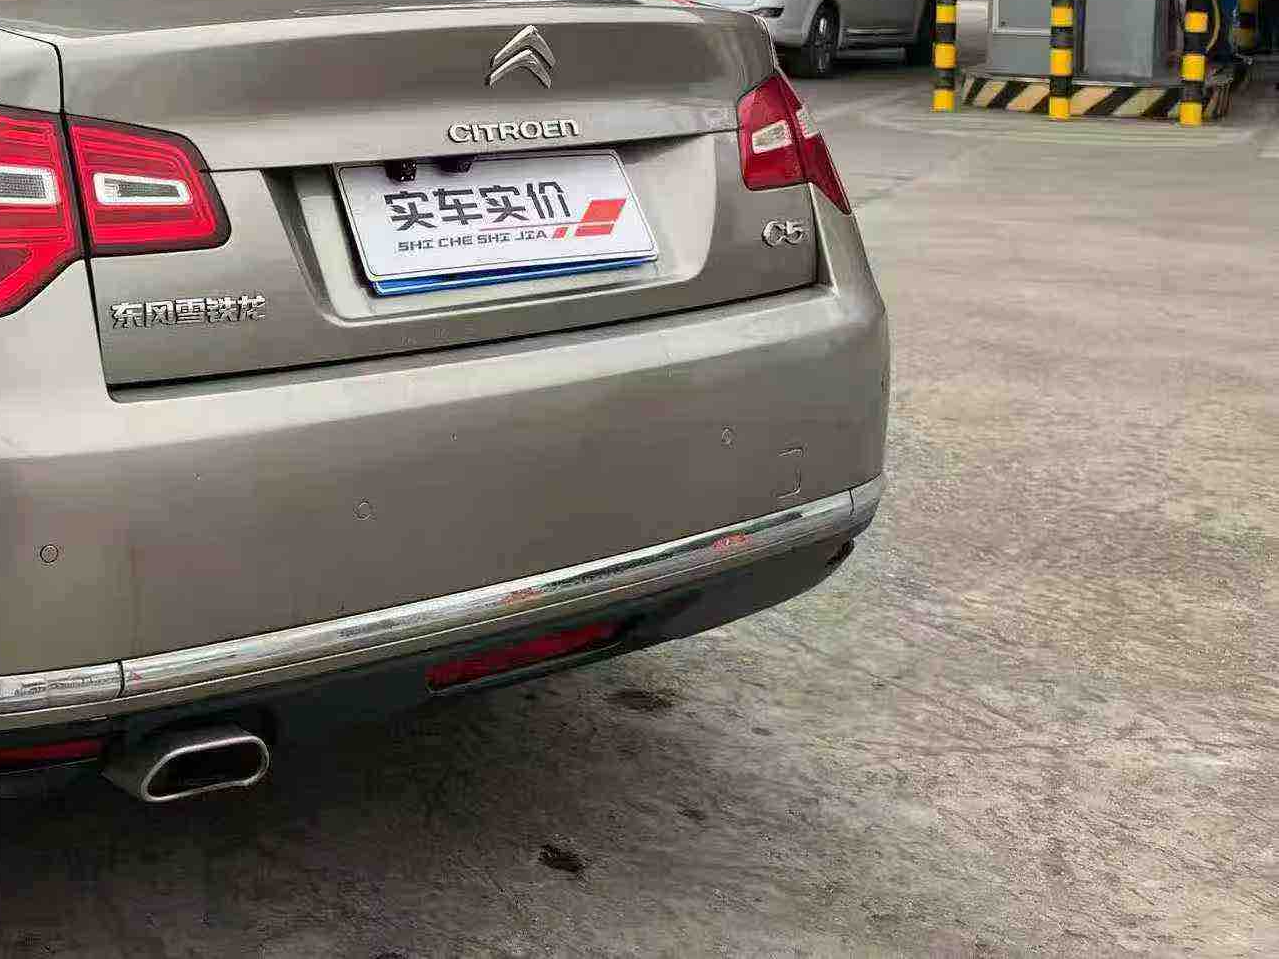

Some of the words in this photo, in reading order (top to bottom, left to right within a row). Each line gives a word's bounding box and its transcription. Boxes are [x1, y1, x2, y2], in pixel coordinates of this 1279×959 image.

[448, 118, 581, 143] CITROEN
[384, 180, 571, 231] 实车实价
[398, 239, 434, 252] SHI
[438, 236, 474, 248] CHE
[477, 232, 511, 245] SHI
[514, 229, 548, 241] JIA
[762, 220, 809, 248] C5
[110, 294, 267, 329] 东风雪铁龙
